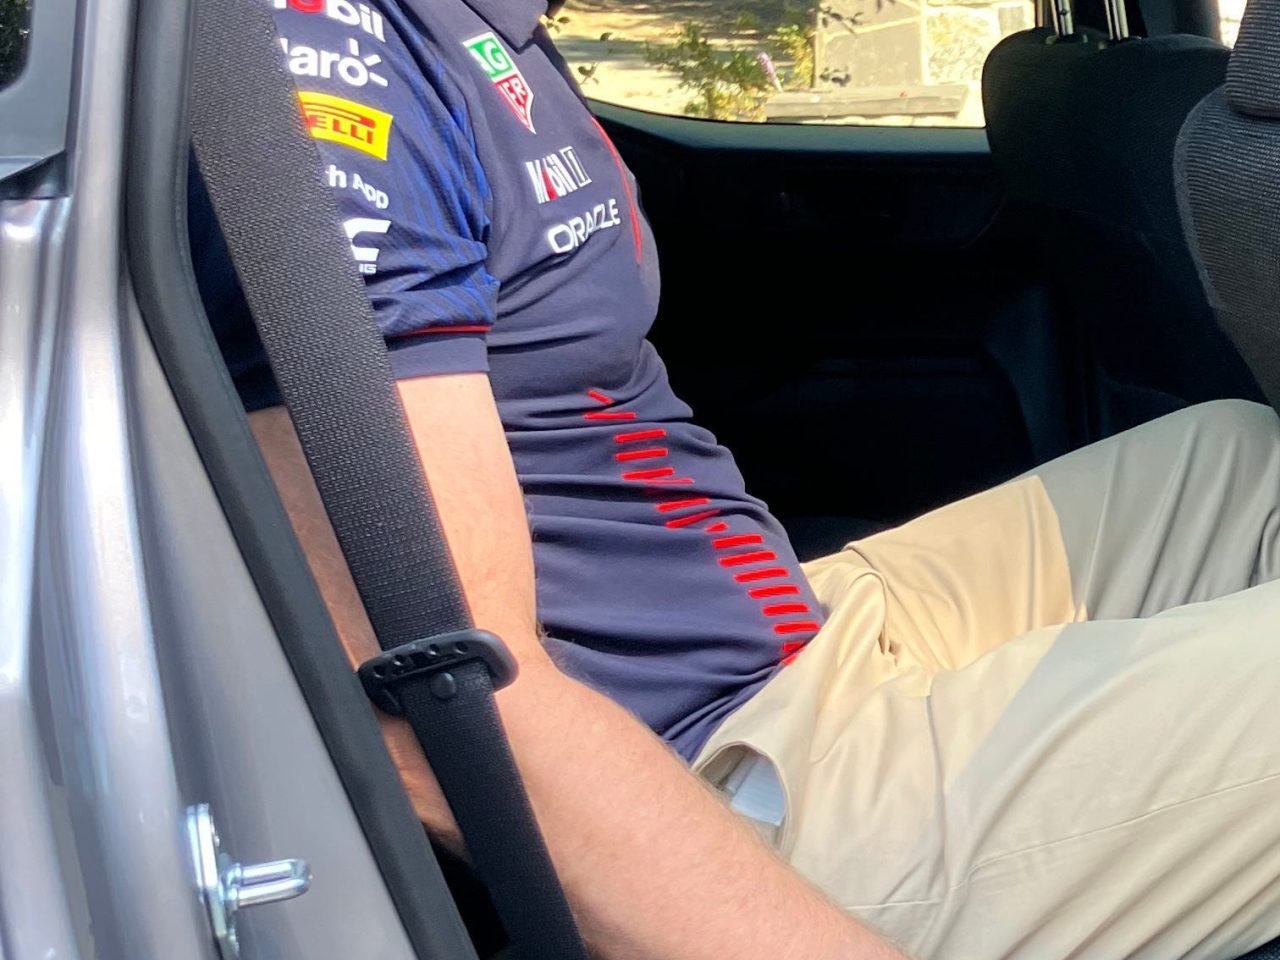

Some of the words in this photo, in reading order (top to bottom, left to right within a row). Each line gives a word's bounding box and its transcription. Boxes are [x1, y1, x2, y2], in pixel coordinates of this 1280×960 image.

[273, 0, 386, 43] obil
[281, 38, 372, 87] aro
[303, 104, 375, 145] ELLI
[325, 164, 347, 188] h
[352, 173, 389, 209] App
